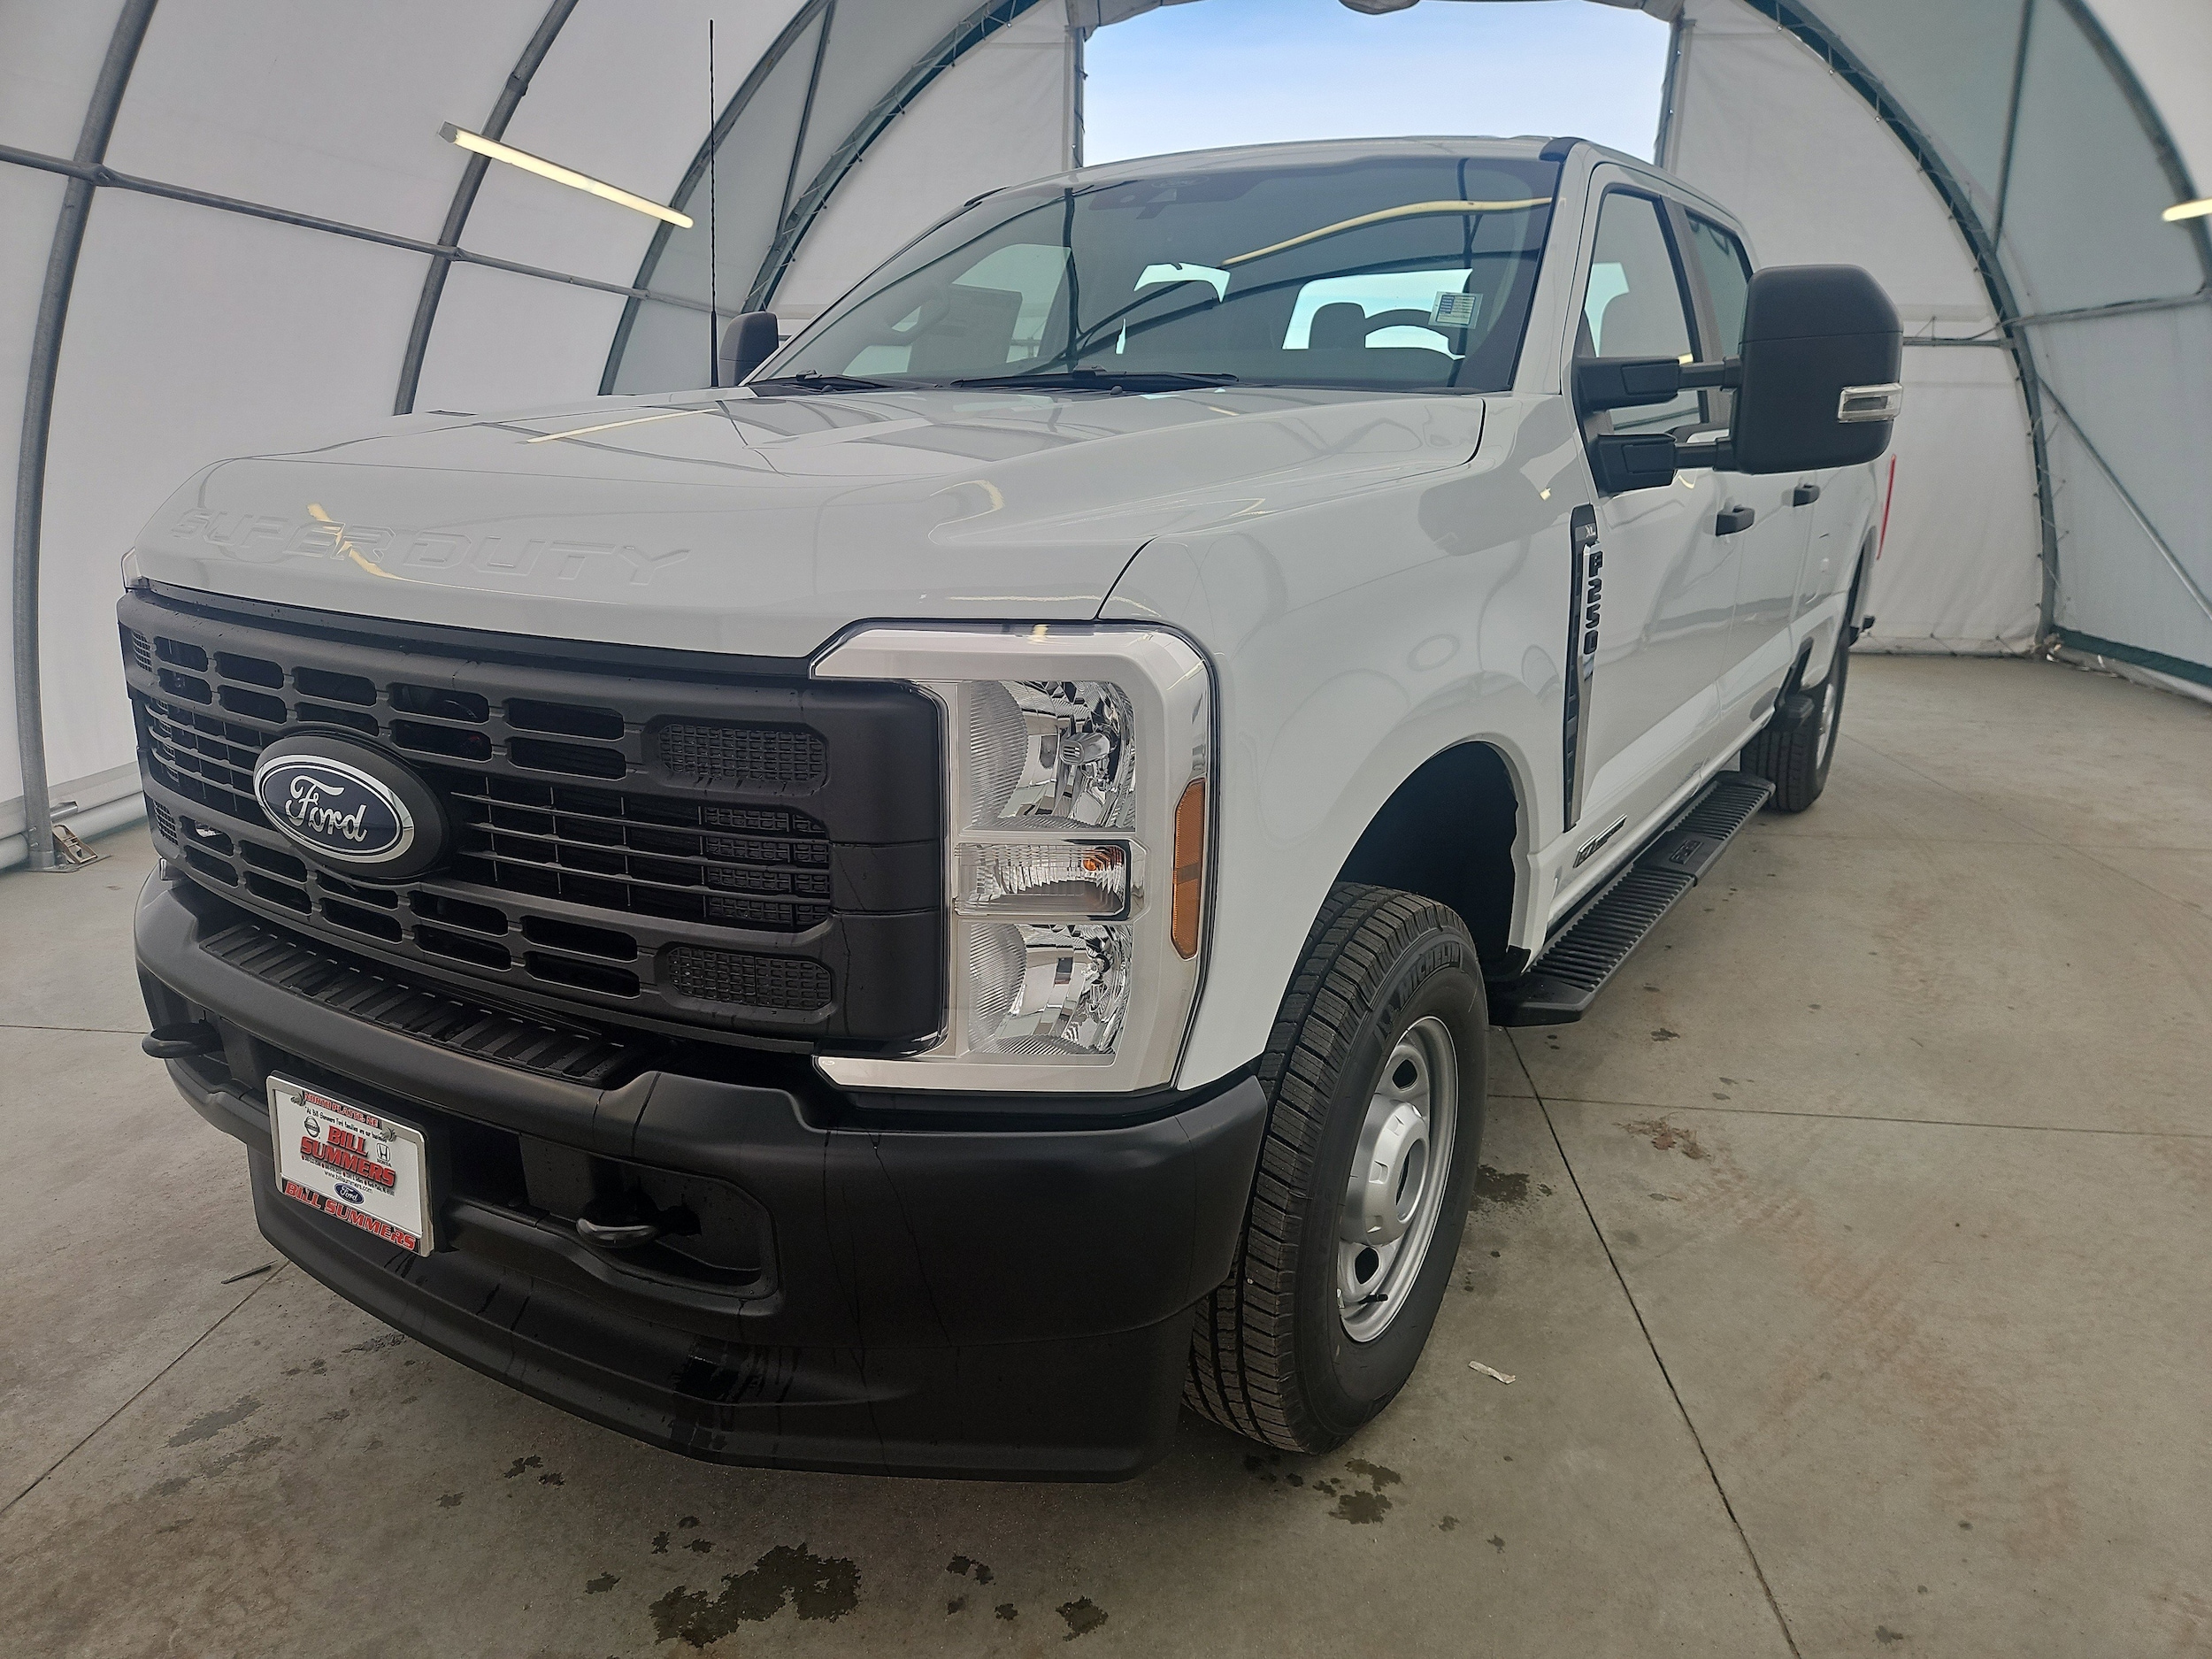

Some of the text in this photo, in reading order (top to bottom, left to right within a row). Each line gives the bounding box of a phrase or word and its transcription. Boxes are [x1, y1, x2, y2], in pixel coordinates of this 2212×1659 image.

[171, 508, 692, 587] SUPER DUTY
[284, 774, 368, 842] Ford
[1397, 941, 1461, 1010] MICHELIN
[300, 1135, 396, 1187] SUMMERS
[327, 1125, 369, 1157] BILL
[284, 1182, 417, 1251] BILL SUMMERS
[340, 1186, 358, 1202] Ford
